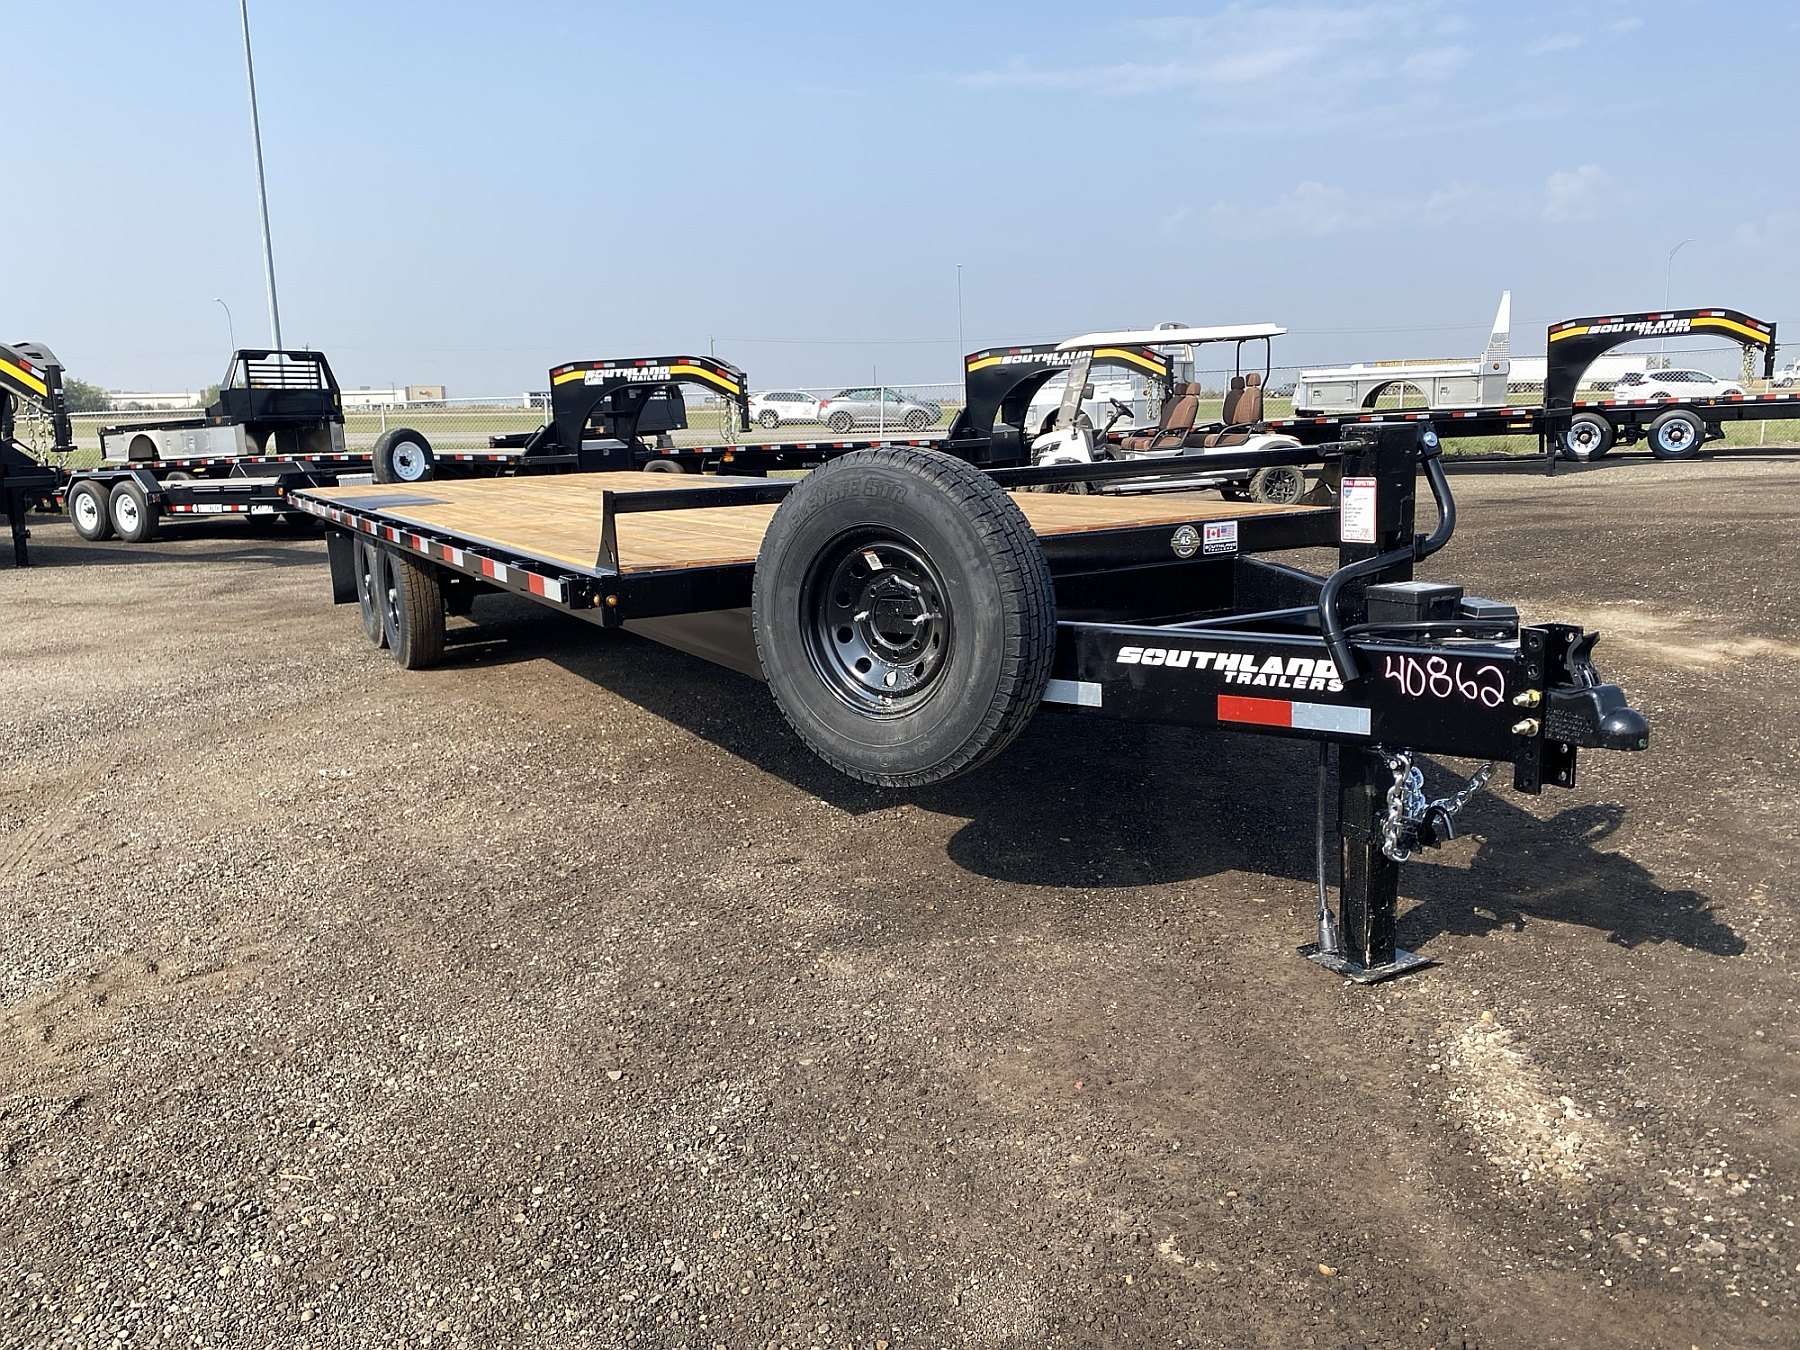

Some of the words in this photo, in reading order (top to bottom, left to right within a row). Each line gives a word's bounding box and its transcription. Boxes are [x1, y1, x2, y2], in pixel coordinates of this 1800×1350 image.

[1587, 318, 1692, 335] SOUTHLAND
[1638, 326, 1691, 335] TRAILERS
[585, 366, 670, 378] SOUTHLAND
[626, 374, 671, 382] TRAILERS
[1116, 646, 1340, 678] SOUTHLAND
[1224, 670, 1344, 692] TRAILERS
[1384, 655, 1505, 707] 40862
